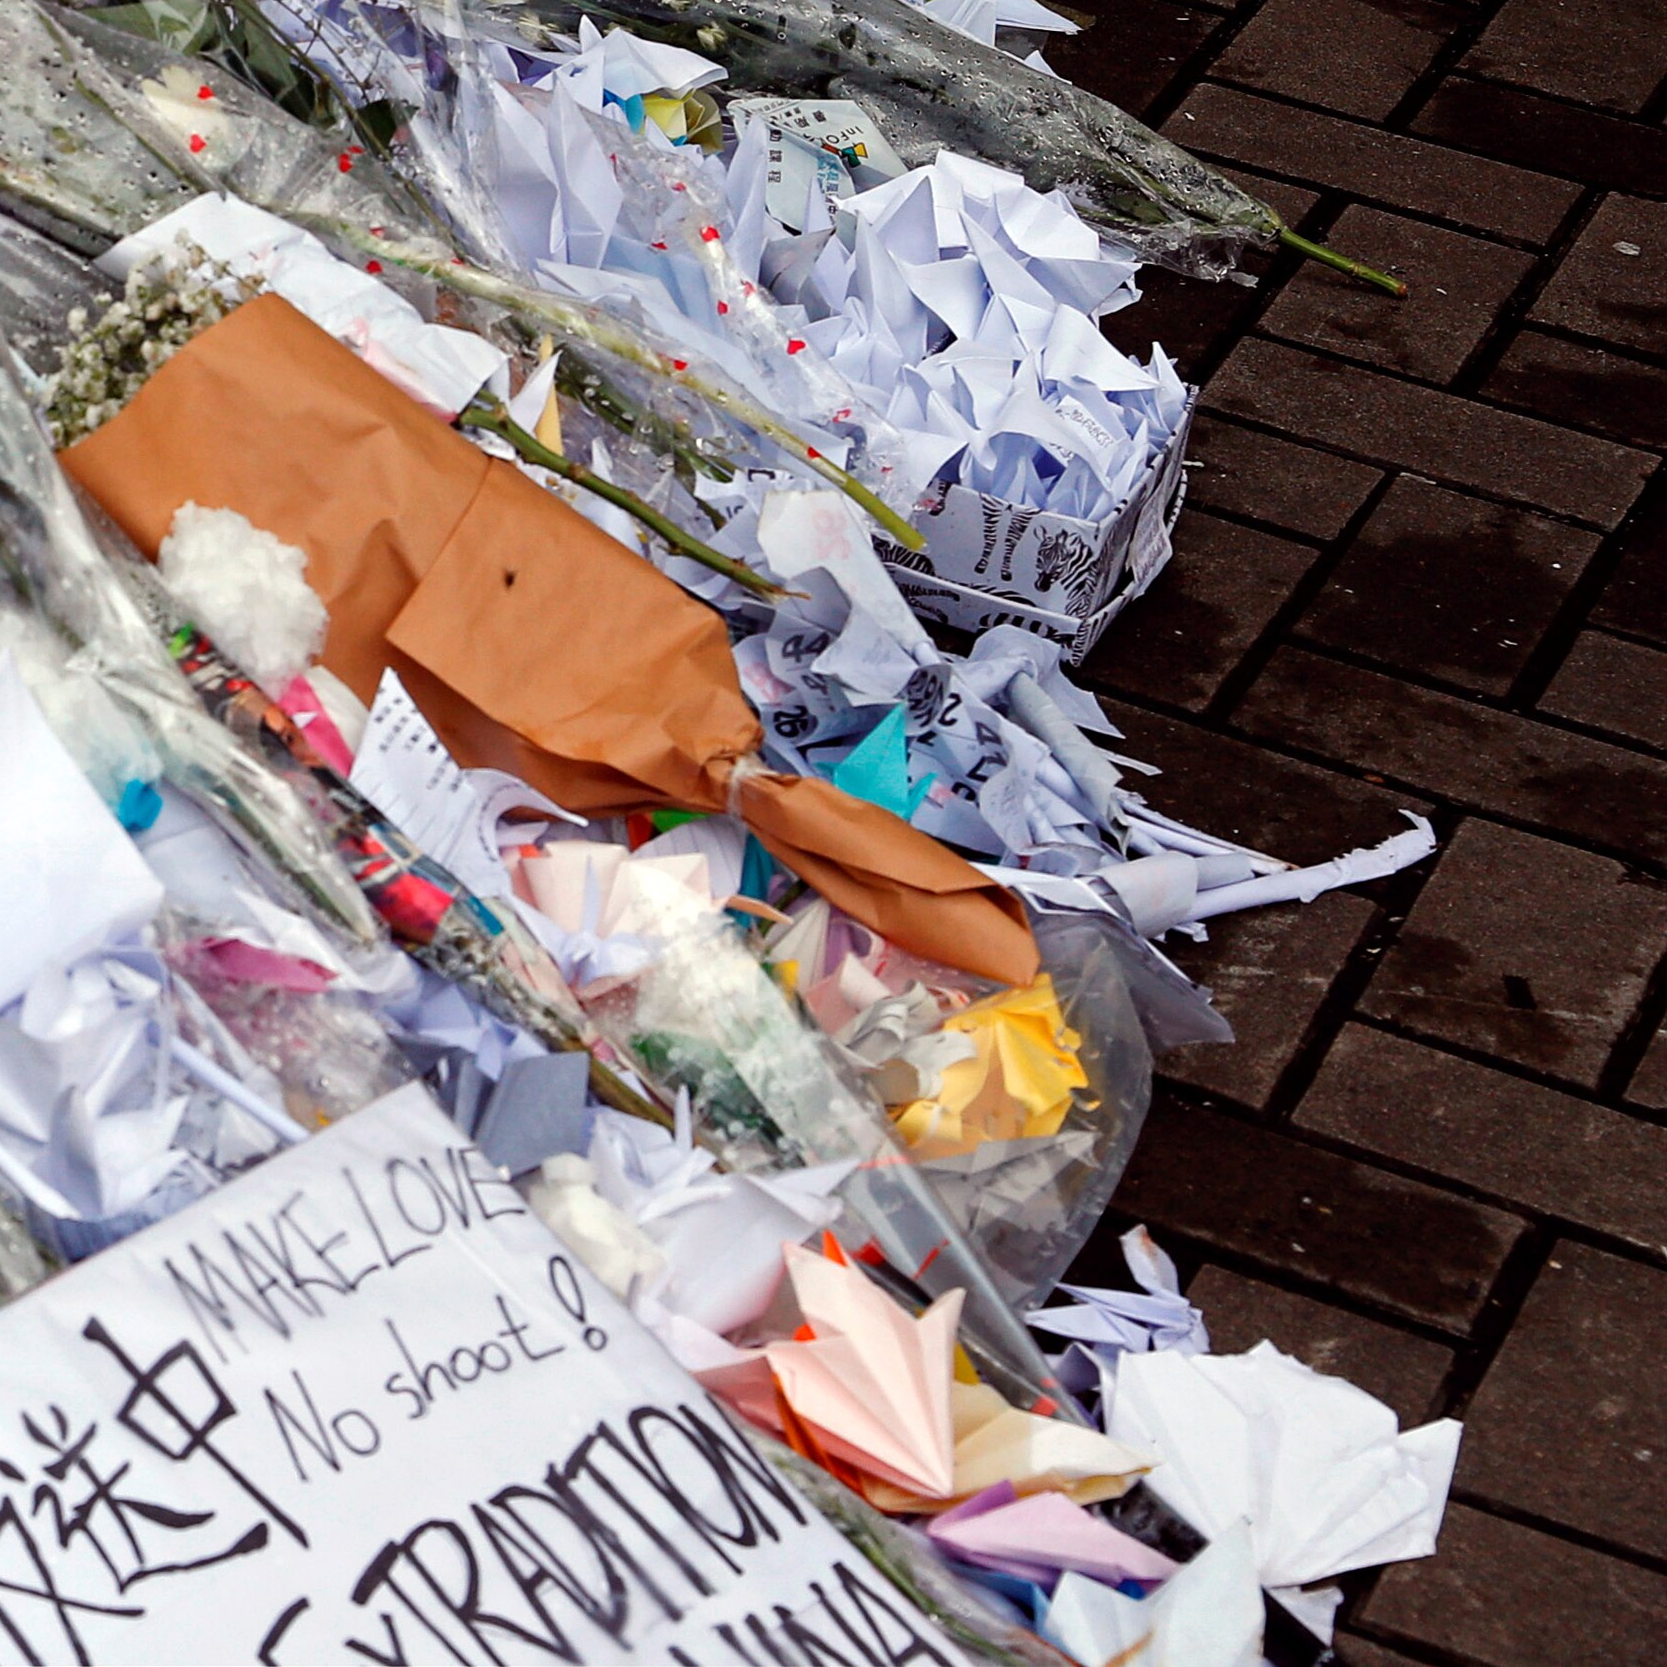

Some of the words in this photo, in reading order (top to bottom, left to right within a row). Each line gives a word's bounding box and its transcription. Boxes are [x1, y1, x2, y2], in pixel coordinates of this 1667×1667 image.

[164, 1190, 382, 1366] MAKE
[342, 1147, 526, 1269] LOVE
[263, 1368, 381, 1483] No
